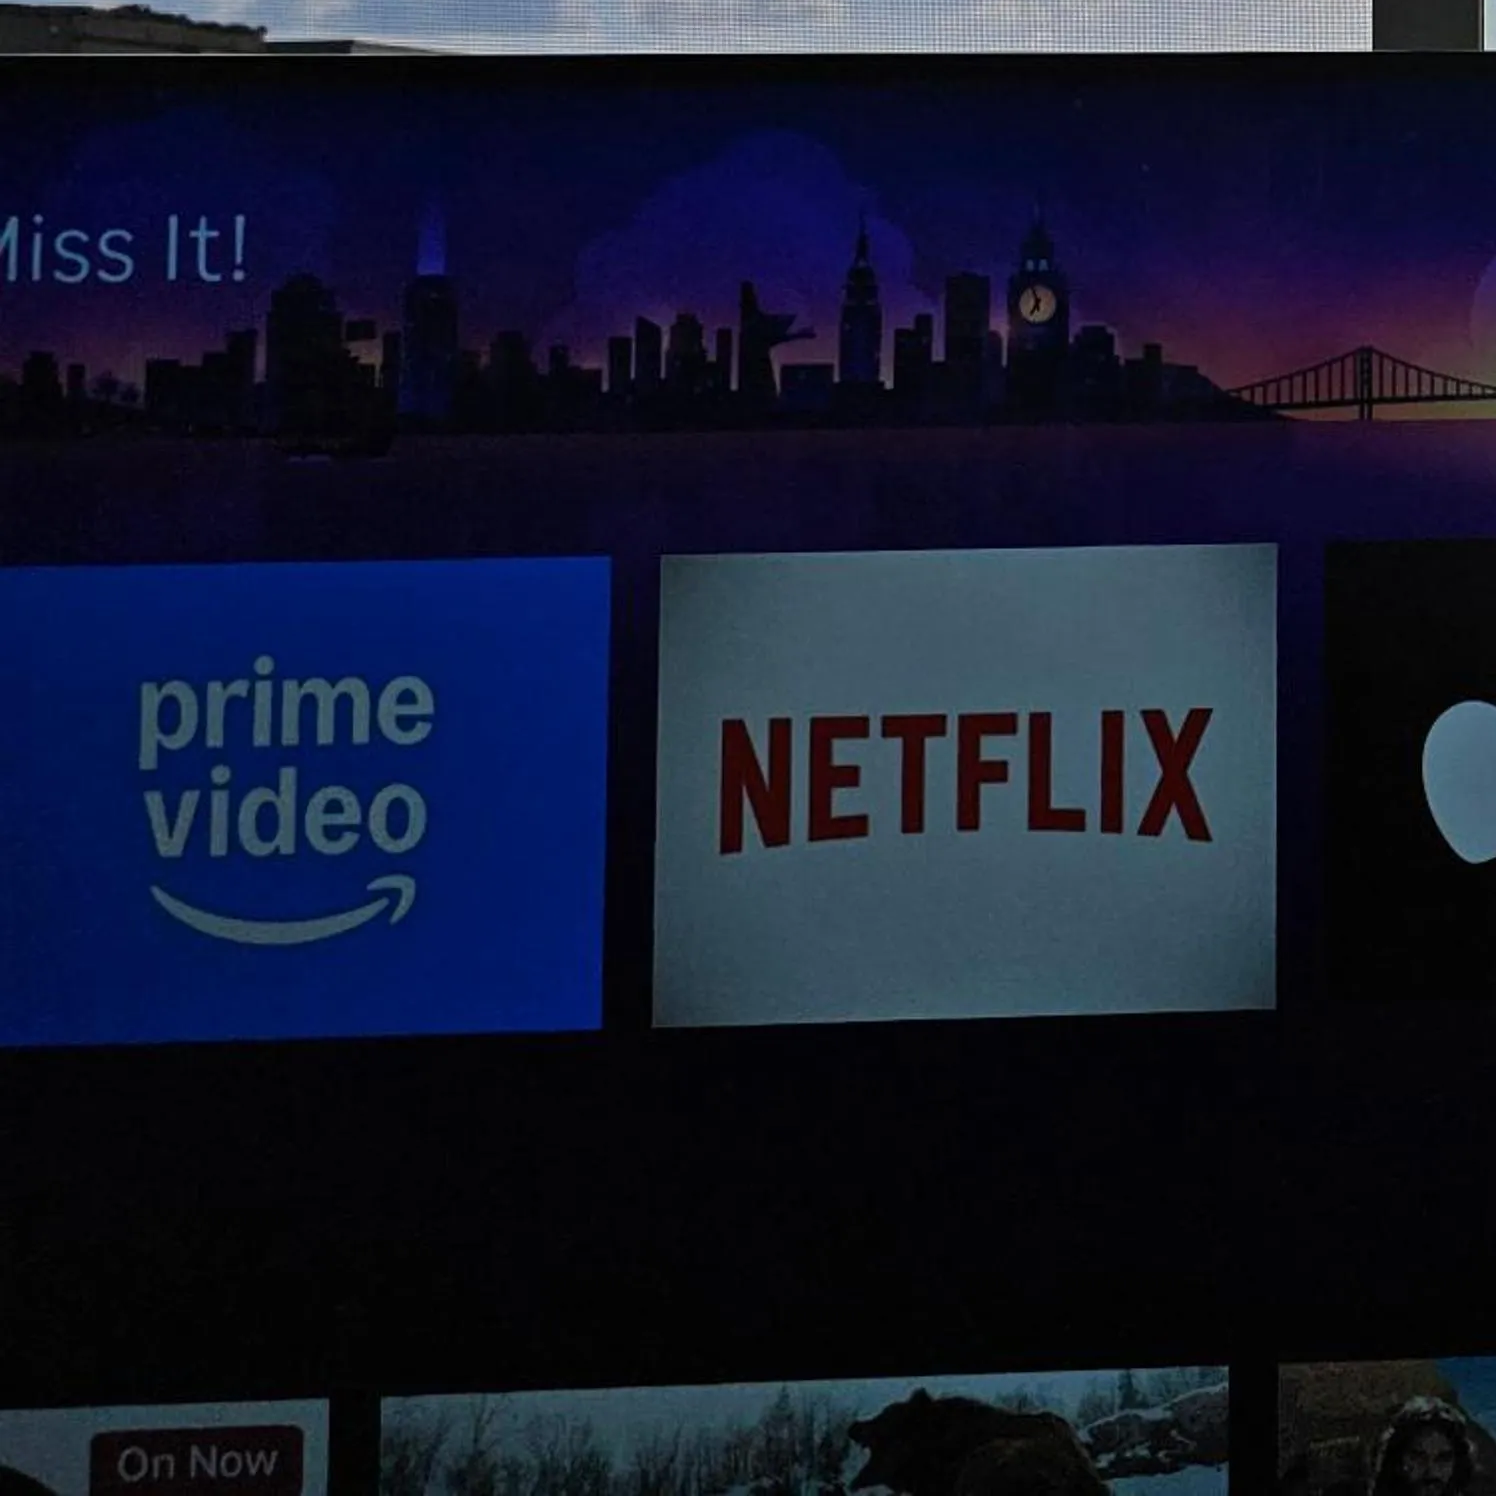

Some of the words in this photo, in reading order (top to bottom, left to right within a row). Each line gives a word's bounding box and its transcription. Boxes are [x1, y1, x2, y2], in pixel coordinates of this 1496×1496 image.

[167, 214, 246, 283] It!
[138, 655, 436, 771] prime
[143, 765, 429, 858] video
[719, 707, 1214, 855] NETFLIX
[117, 1445, 175, 1483] On
[190, 1443, 279, 1480] Now
